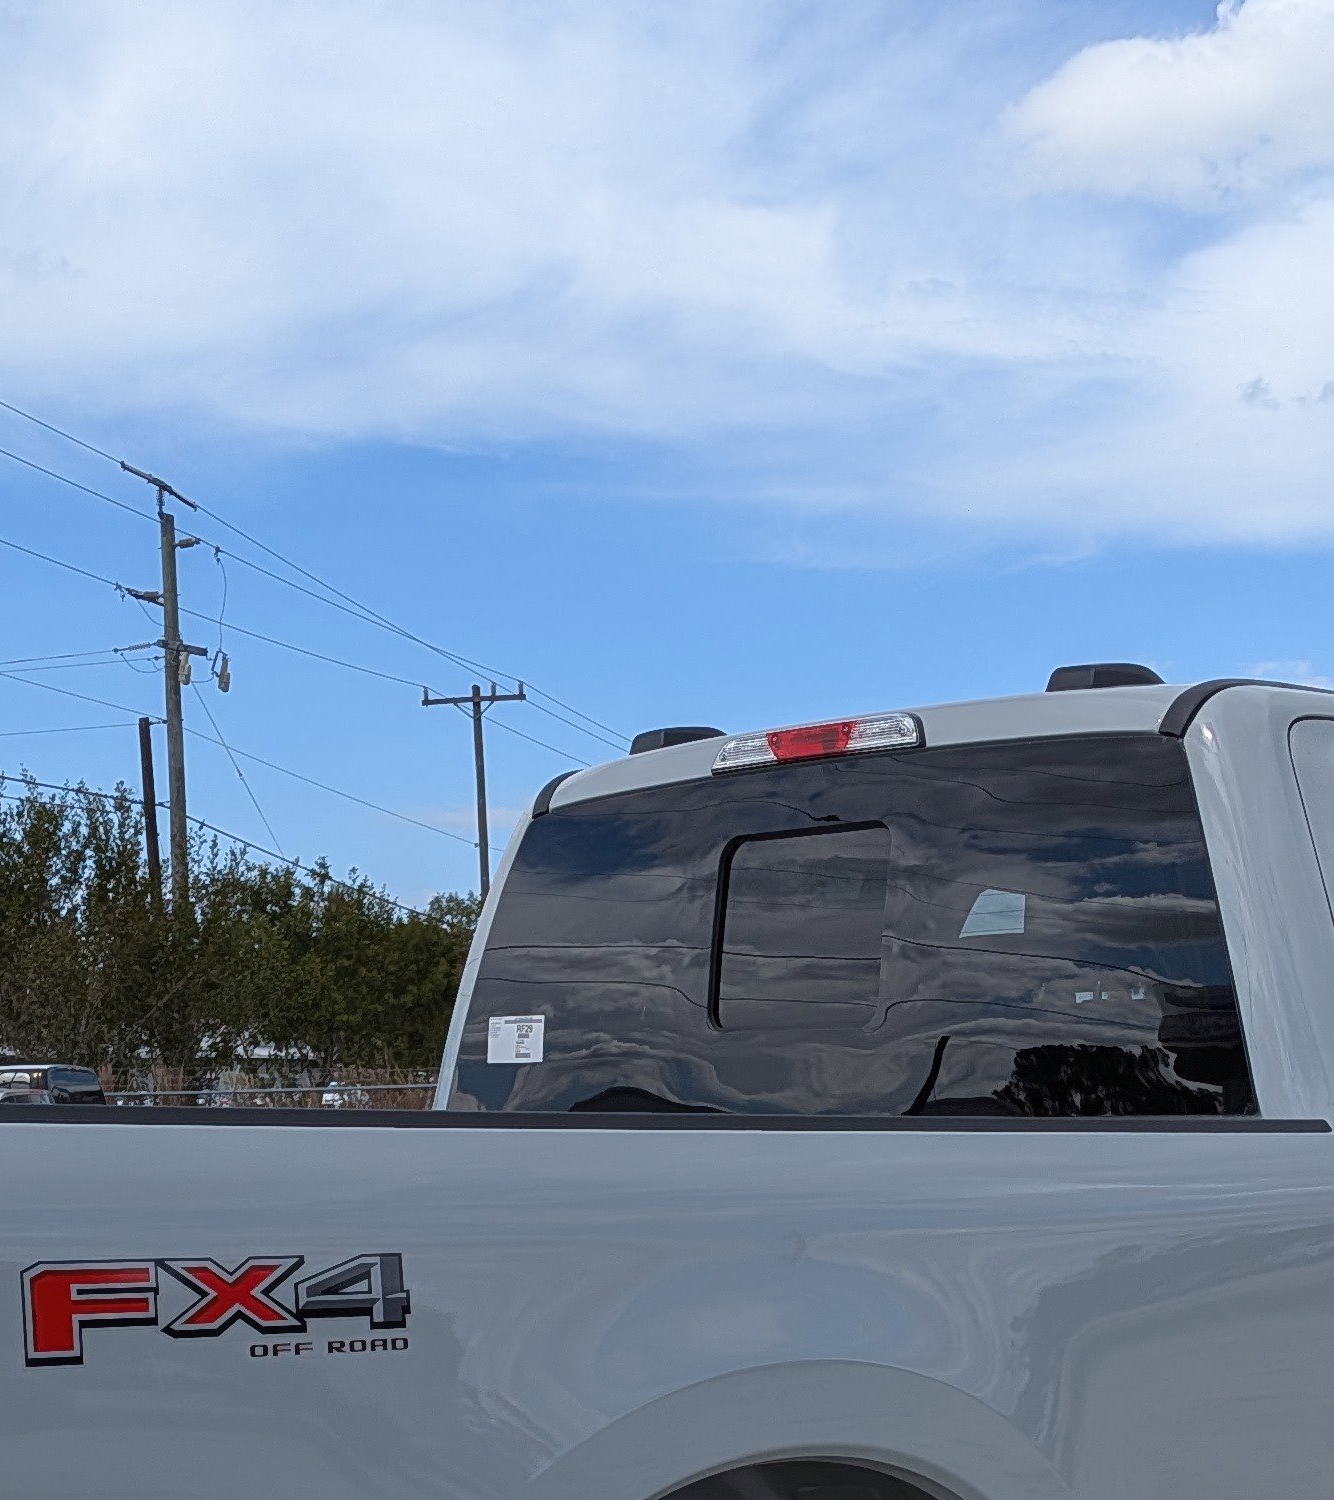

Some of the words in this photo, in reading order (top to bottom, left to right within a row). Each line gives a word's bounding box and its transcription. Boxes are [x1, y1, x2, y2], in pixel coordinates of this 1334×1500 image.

[20, 1253, 411, 1367] FX4
[249, 1341, 314, 1358] OFF
[326, 1336, 409, 1354] ROAD
